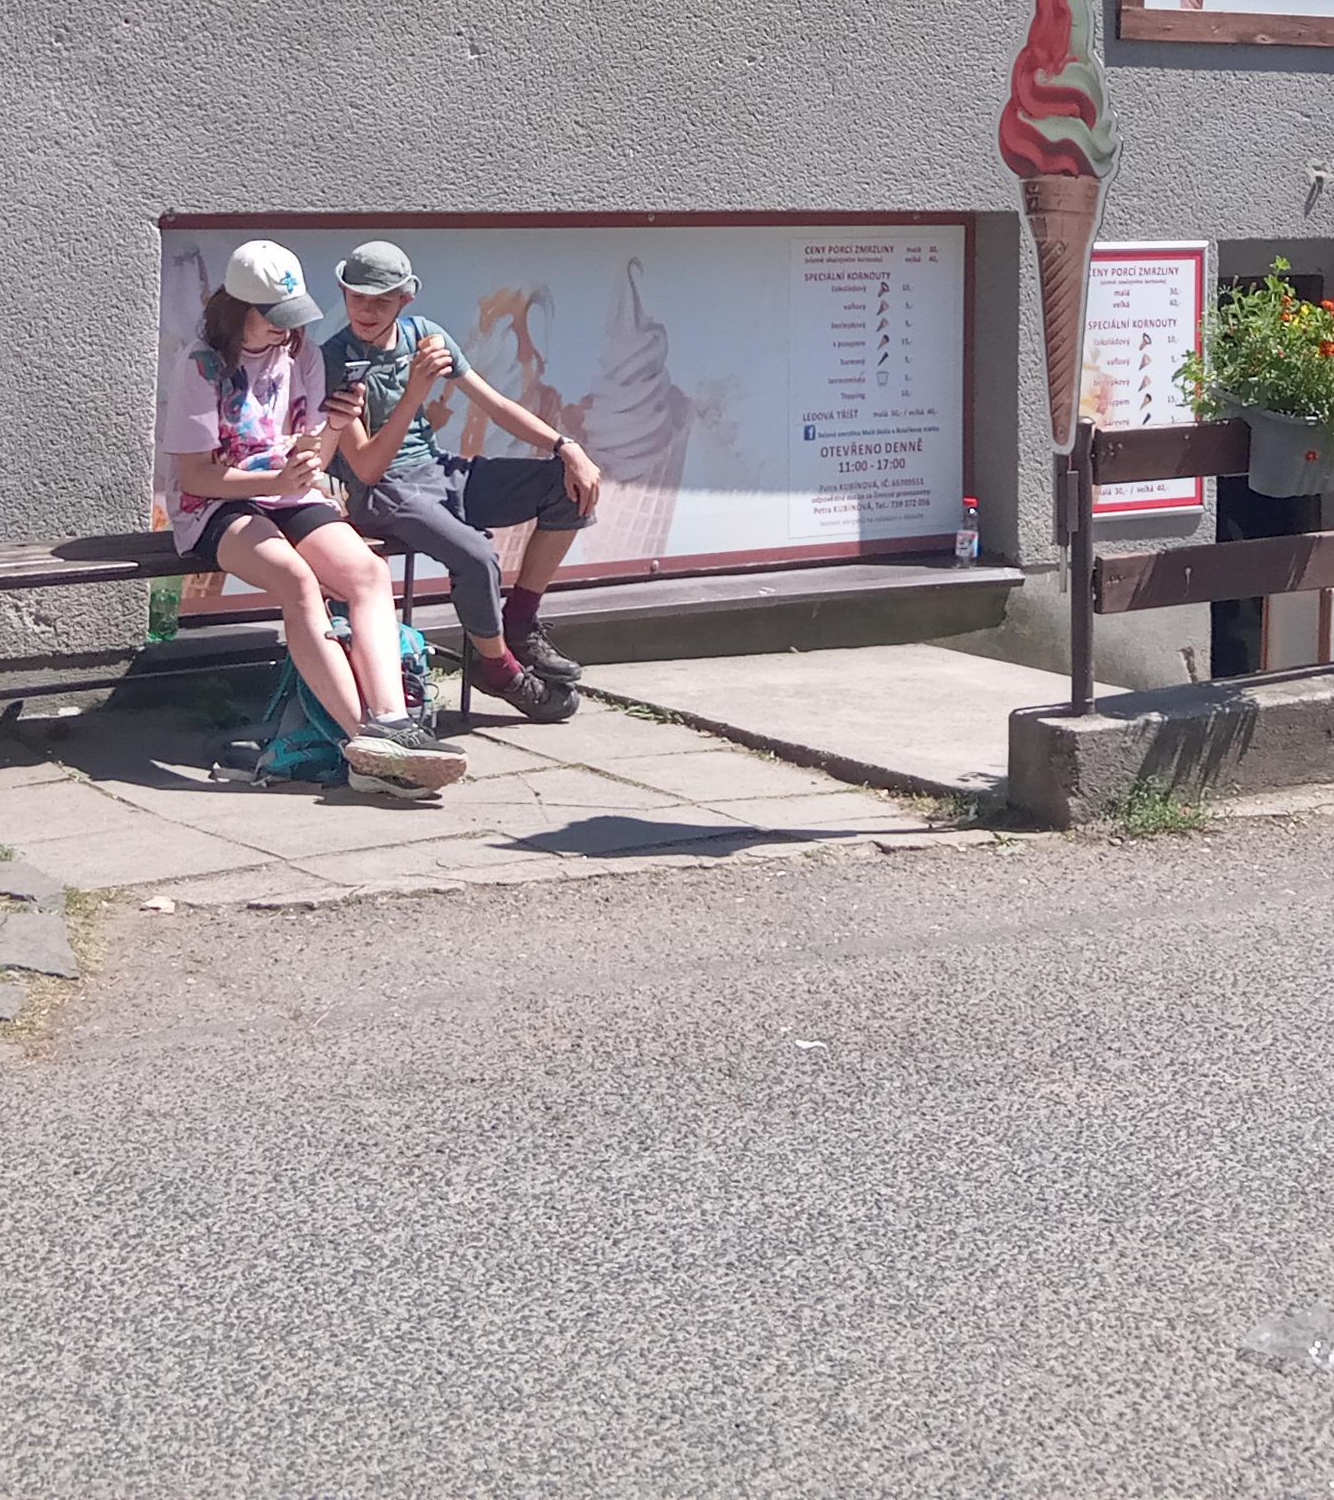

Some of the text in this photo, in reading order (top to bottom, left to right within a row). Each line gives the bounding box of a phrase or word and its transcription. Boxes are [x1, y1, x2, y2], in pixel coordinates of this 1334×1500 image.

[804, 246, 826, 255] CENY
[828, 243, 853, 254] PORCÍ
[855, 245, 895, 254] ZMRZLINY
[804, 270, 891, 281] SPECIÁLNÍ KORNOUTY
[1111, 266, 1136, 276] PORCÍ
[1139, 266, 1179, 276] ZMRZLINY
[1088, 316, 1178, 330] SPECIÁLNÍ KORNOUTY
[803, 410, 834, 422] LEDOVÁ
[820, 438, 923, 458] OTEVŘENO DENNĚ
[838, 461, 867, 473] 11:00
[877, 458, 906, 471] 17:00
[1136, 485, 1154, 493] velká
